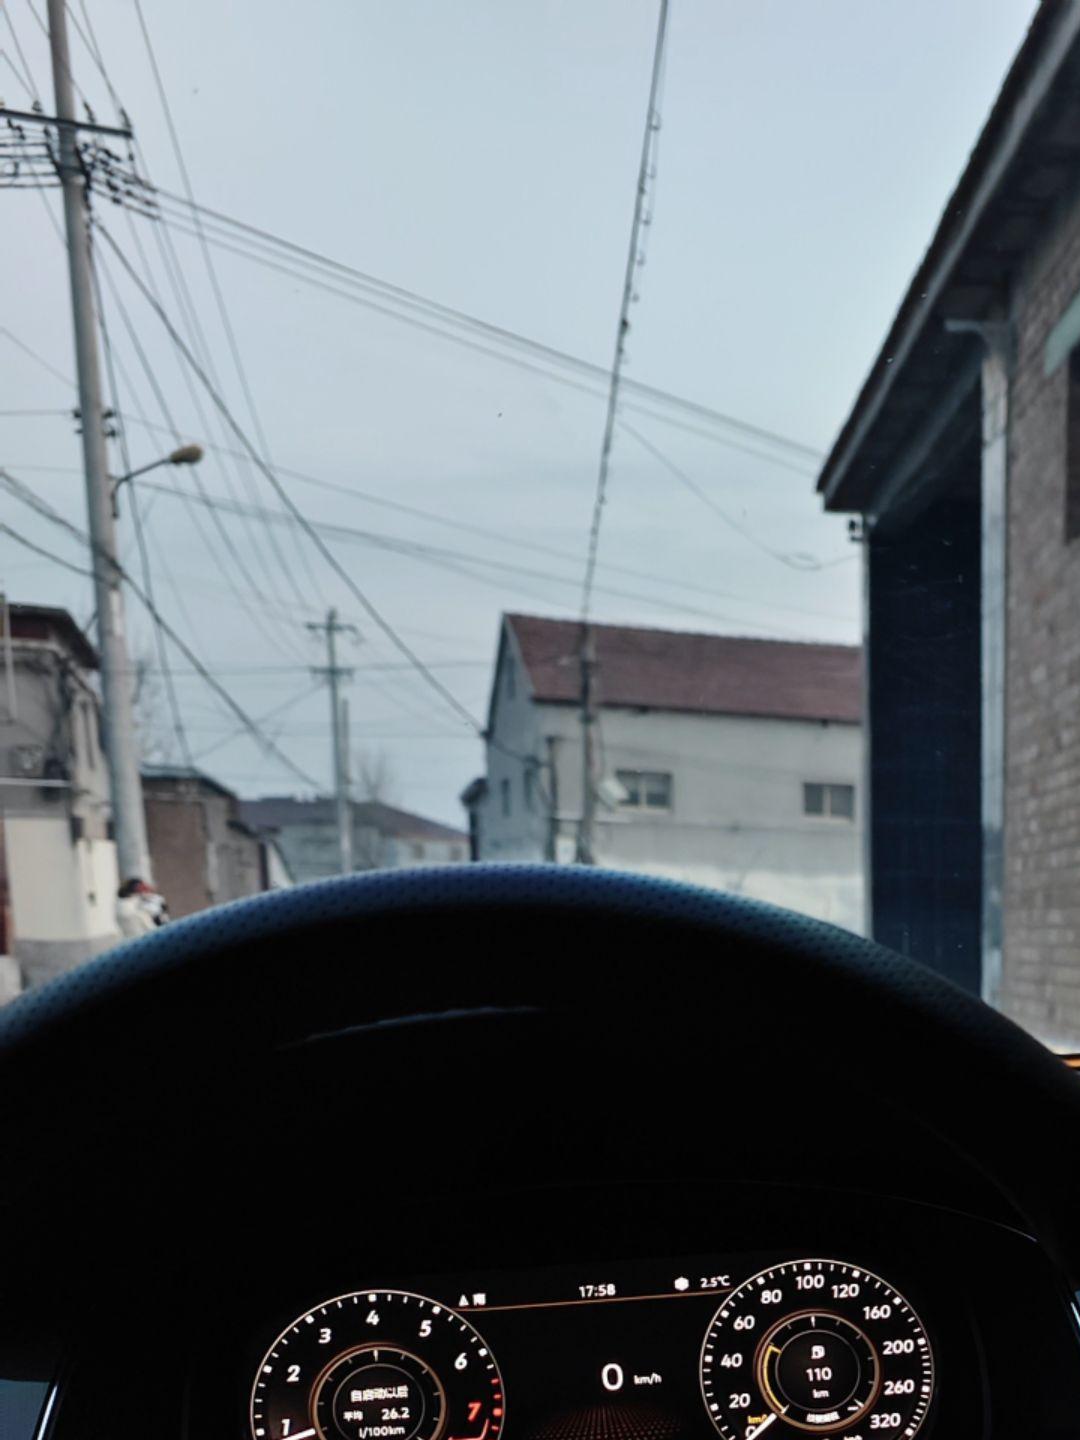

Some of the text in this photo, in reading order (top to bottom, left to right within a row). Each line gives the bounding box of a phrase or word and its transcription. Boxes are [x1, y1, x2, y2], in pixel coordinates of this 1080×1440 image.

[796, 1275, 824, 1289] 100
[579, 1284, 615, 1297] 17:58
[761, 1290, 782, 1304] 80
[832, 1284, 859, 1298] 120
[366, 1310, 379, 1325] 4
[863, 1305, 891, 1319] 160
[419, 1320, 431, 1337] 5
[734, 1315, 755, 1330] 60
[319, 1328, 331, 1343] 3
[883, 1339, 914, 1355] 200
[455, 1353, 467, 1370] 6
[721, 1353, 742, 1368] 40
[287, 1365, 300, 1382] 2
[602, 1364, 661, 1391] 0 km/h
[806, 1367, 832, 1381] 110
[813, 1389, 829, 1398] km
[884, 1380, 914, 1395] 260
[729, 1393, 750, 1408] 20
[382, 1407, 409, 1420] 26.2
[468, 1402, 481, 1421] 7
[870, 1413, 901, 1428] 320
